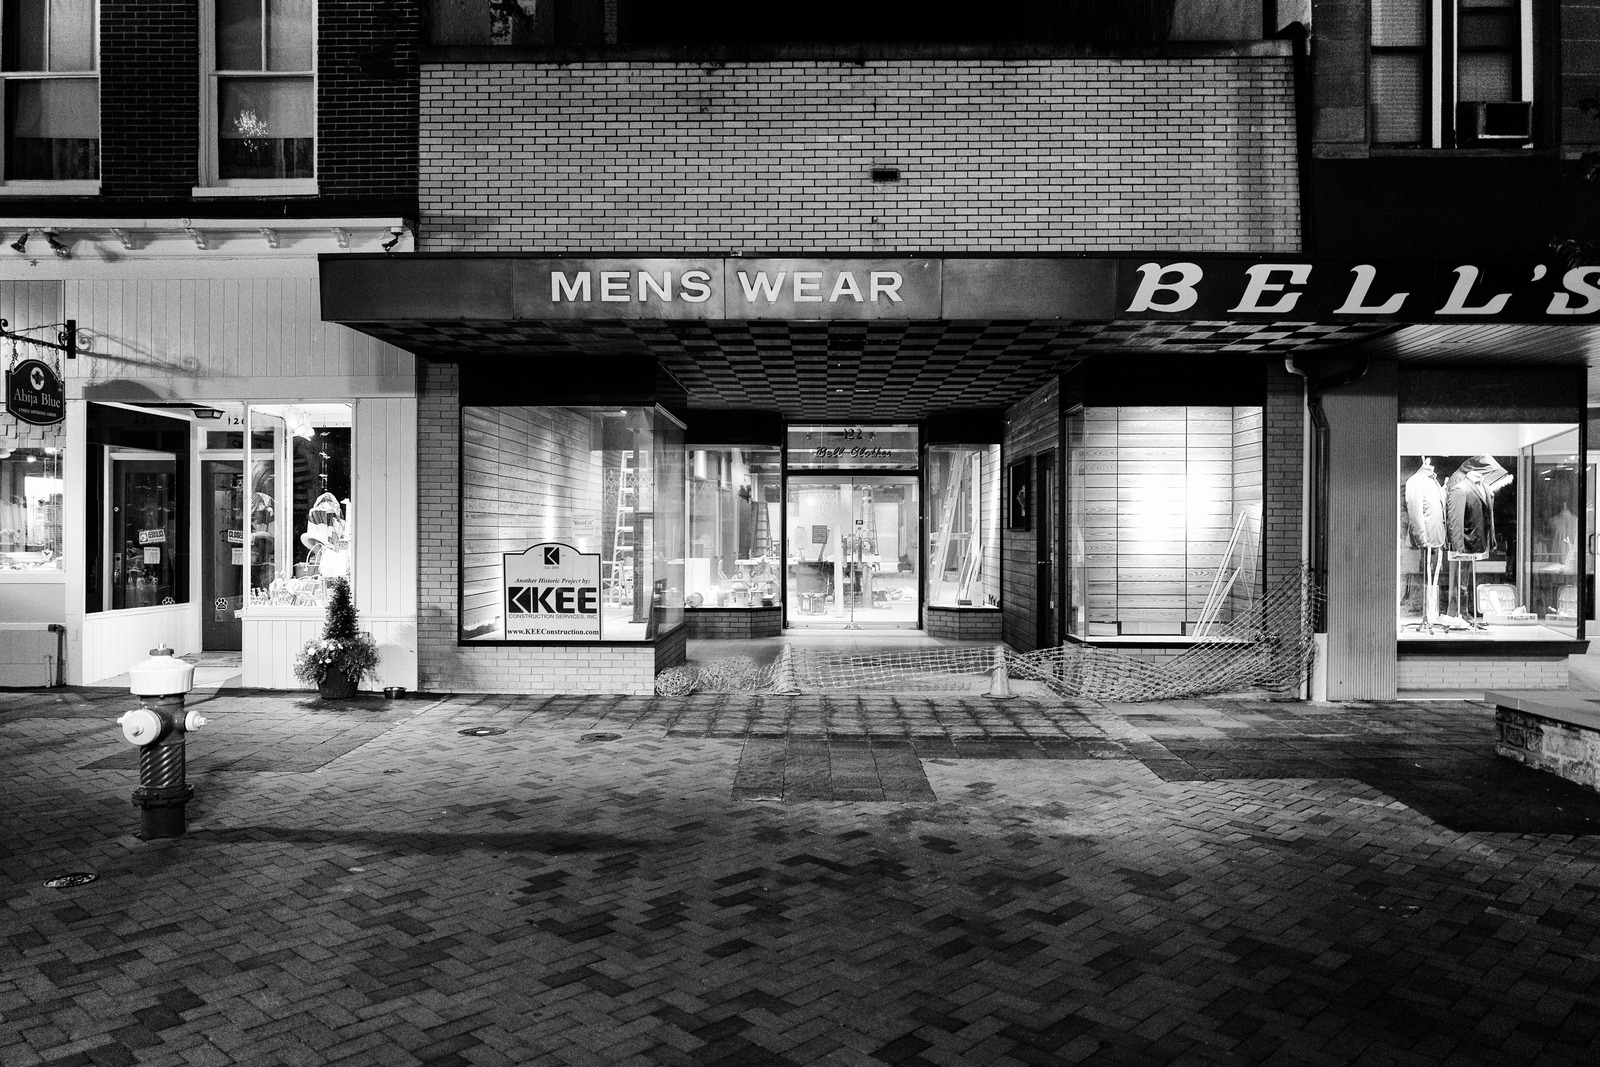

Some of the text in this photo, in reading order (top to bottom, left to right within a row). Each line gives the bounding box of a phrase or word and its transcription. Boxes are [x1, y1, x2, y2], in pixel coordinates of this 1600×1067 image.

[551, 271, 903, 302] MENS WEAR
[1125, 262, 1600, 315] BELL'S
[13, 388, 61, 408] Abija Blue
[844, 428, 863, 440] 122
[815, 446, 846, 458] Bell
[228, 530, 244, 540] CLOSE
[507, 628, 599, 636] www.KEEConstruction.com
